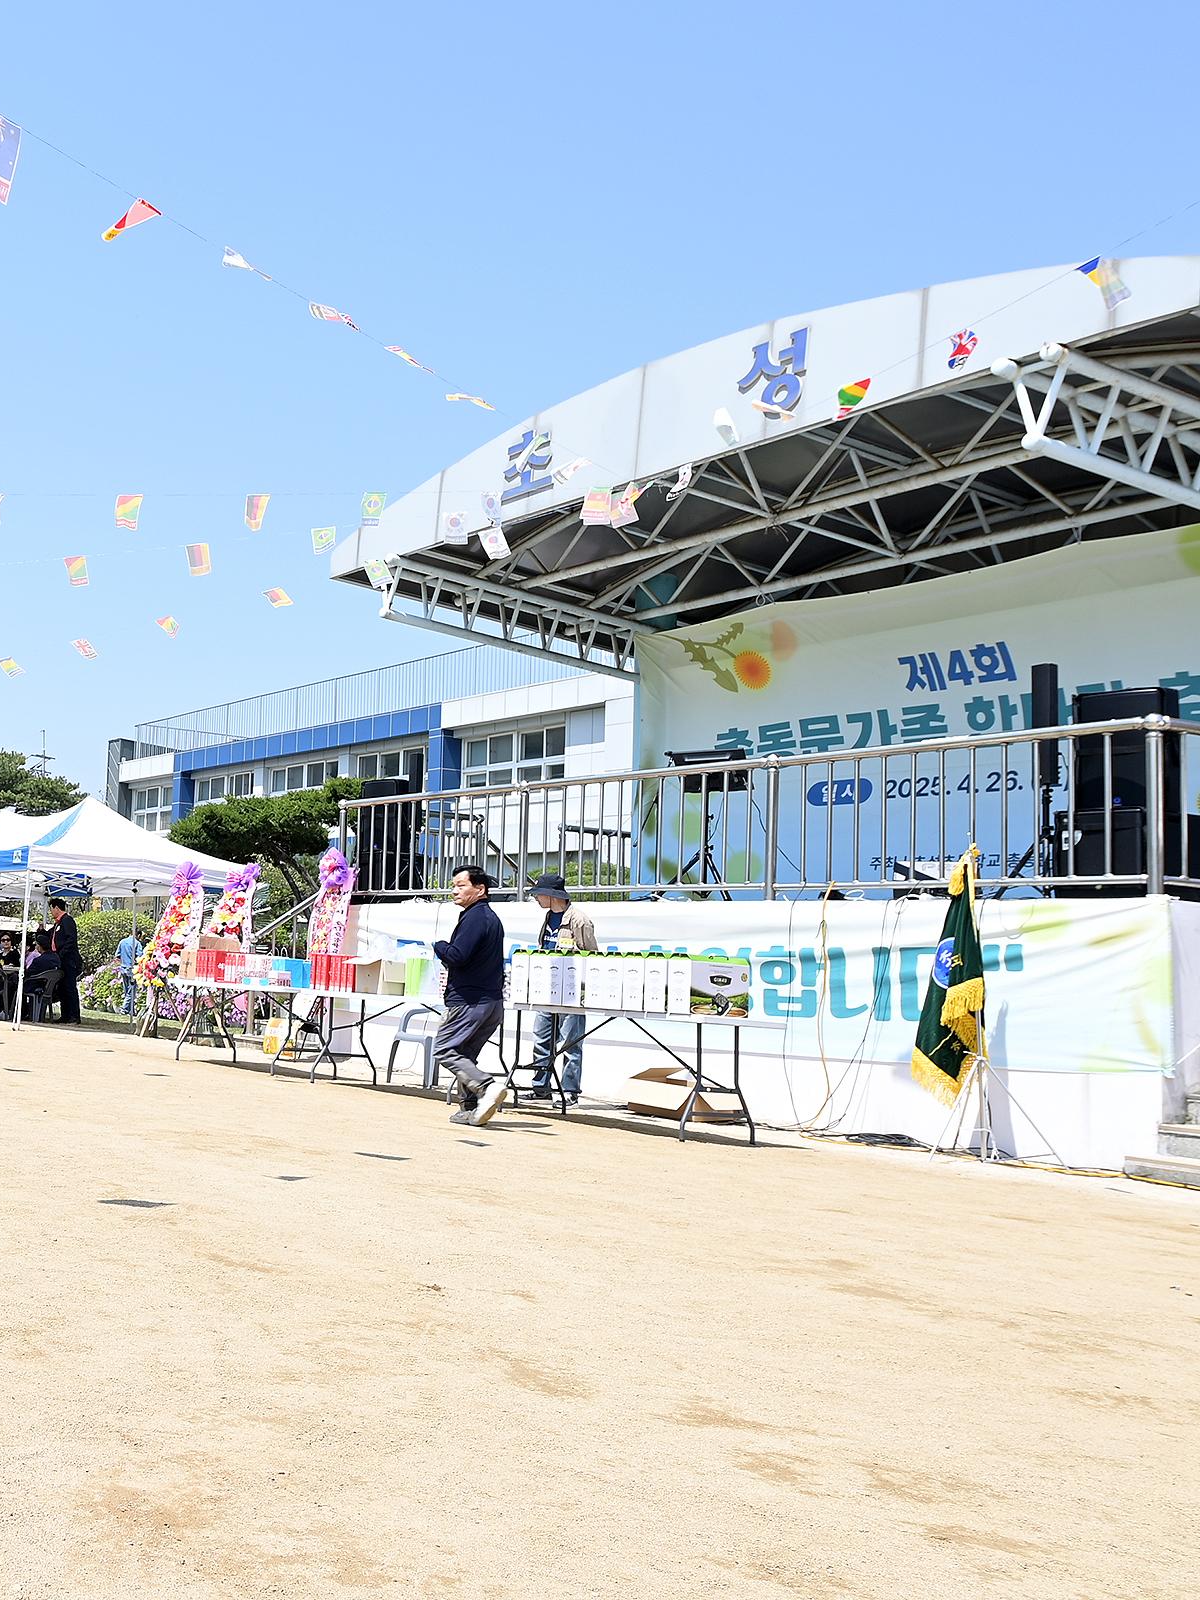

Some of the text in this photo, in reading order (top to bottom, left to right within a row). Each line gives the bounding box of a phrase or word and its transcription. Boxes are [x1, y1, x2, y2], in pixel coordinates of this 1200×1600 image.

[736, 326, 810, 420] 성
[897, 641, 1018, 693] 제4회
[986, 770, 1024, 793] 26.
